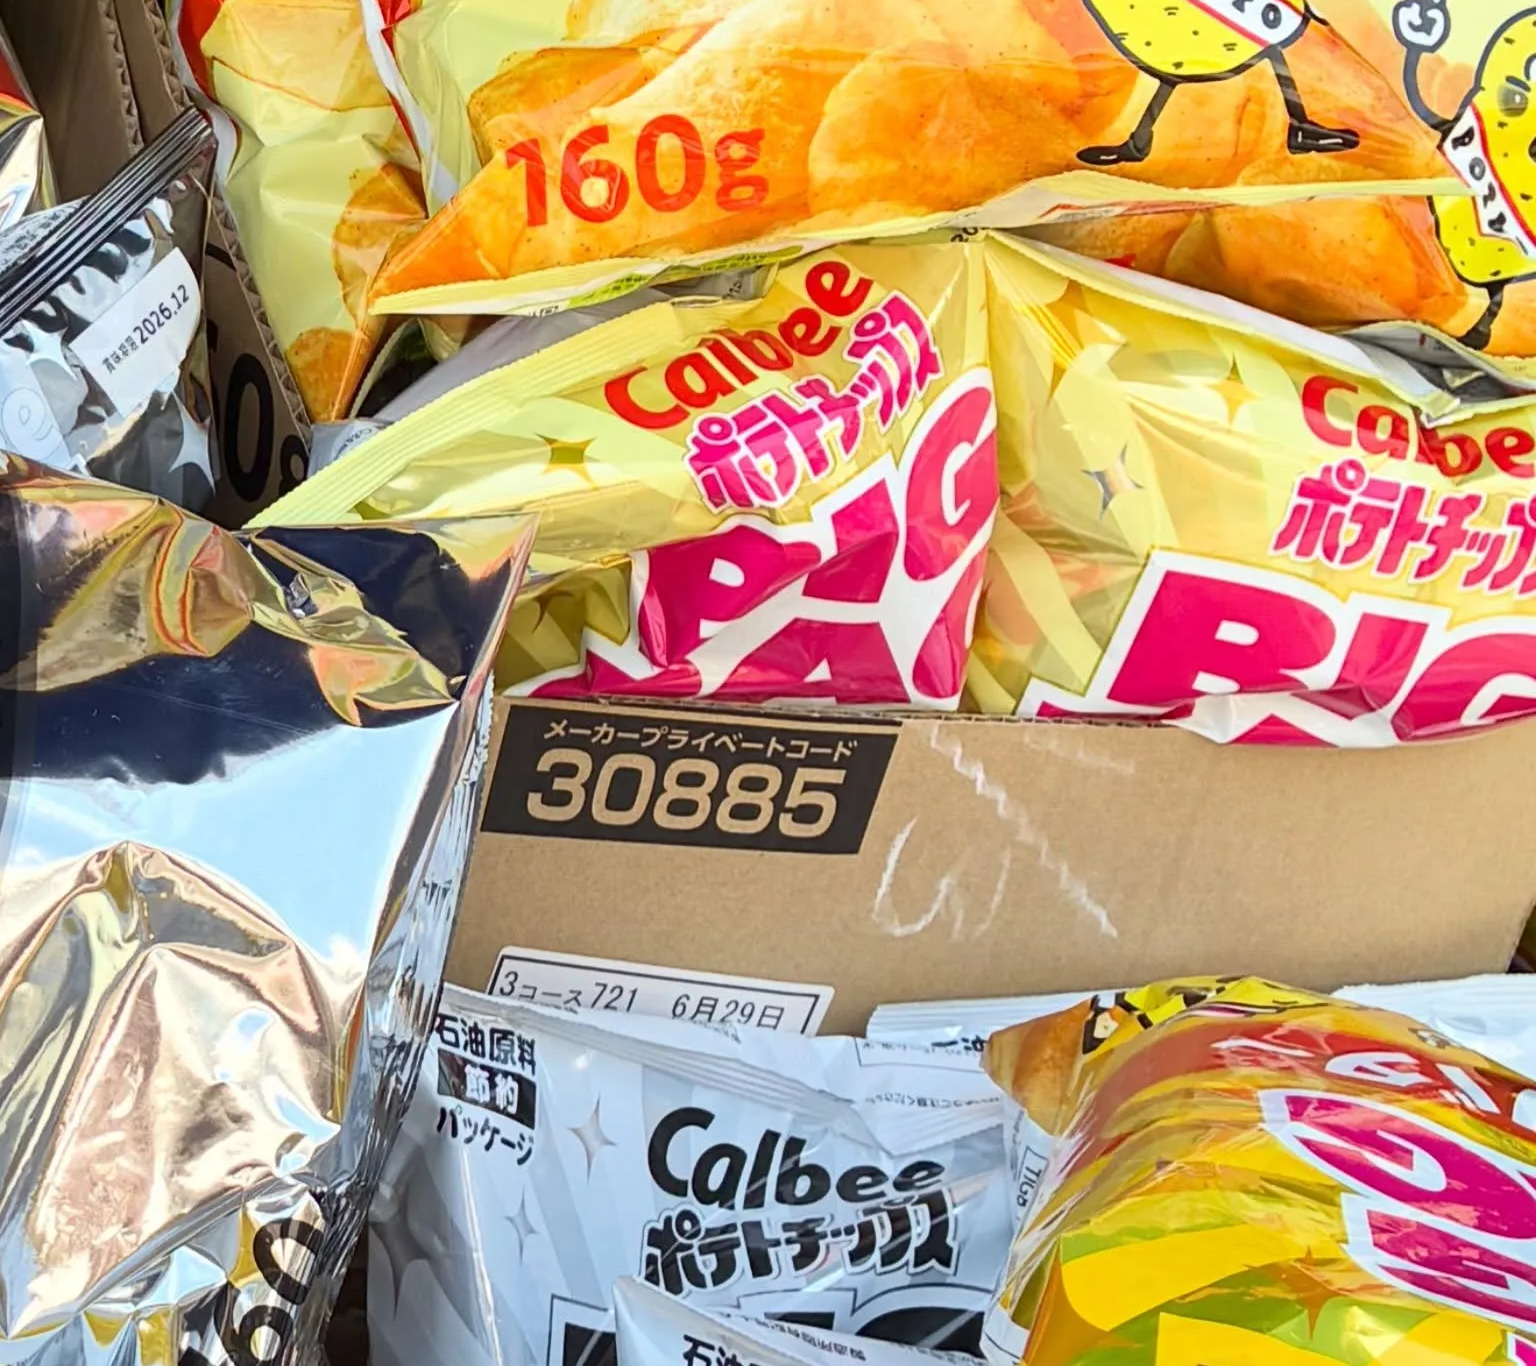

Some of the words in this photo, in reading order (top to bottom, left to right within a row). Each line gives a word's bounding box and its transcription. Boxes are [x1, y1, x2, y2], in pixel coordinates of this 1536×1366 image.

[504, 113, 767, 229] 160g
[132, 283, 191, 347] 2026.12
[686, 291, 944, 514] ポテトチップス
[543, 718, 858, 762] メーカープライベートコード
[526, 748, 847, 838] 30885
[498, 971, 584, 1010] 3コース
[592, 982, 638, 1014] 721
[671, 993, 787, 1031] 6月29日
[435, 1012, 537, 1077] 石油原料
[463, 1065, 520, 1114] 節約
[435, 1107, 536, 1166] パッケージ
[647, 1106, 946, 1214] Calbee
[643, 1190, 959, 1294] ポテトチップス
